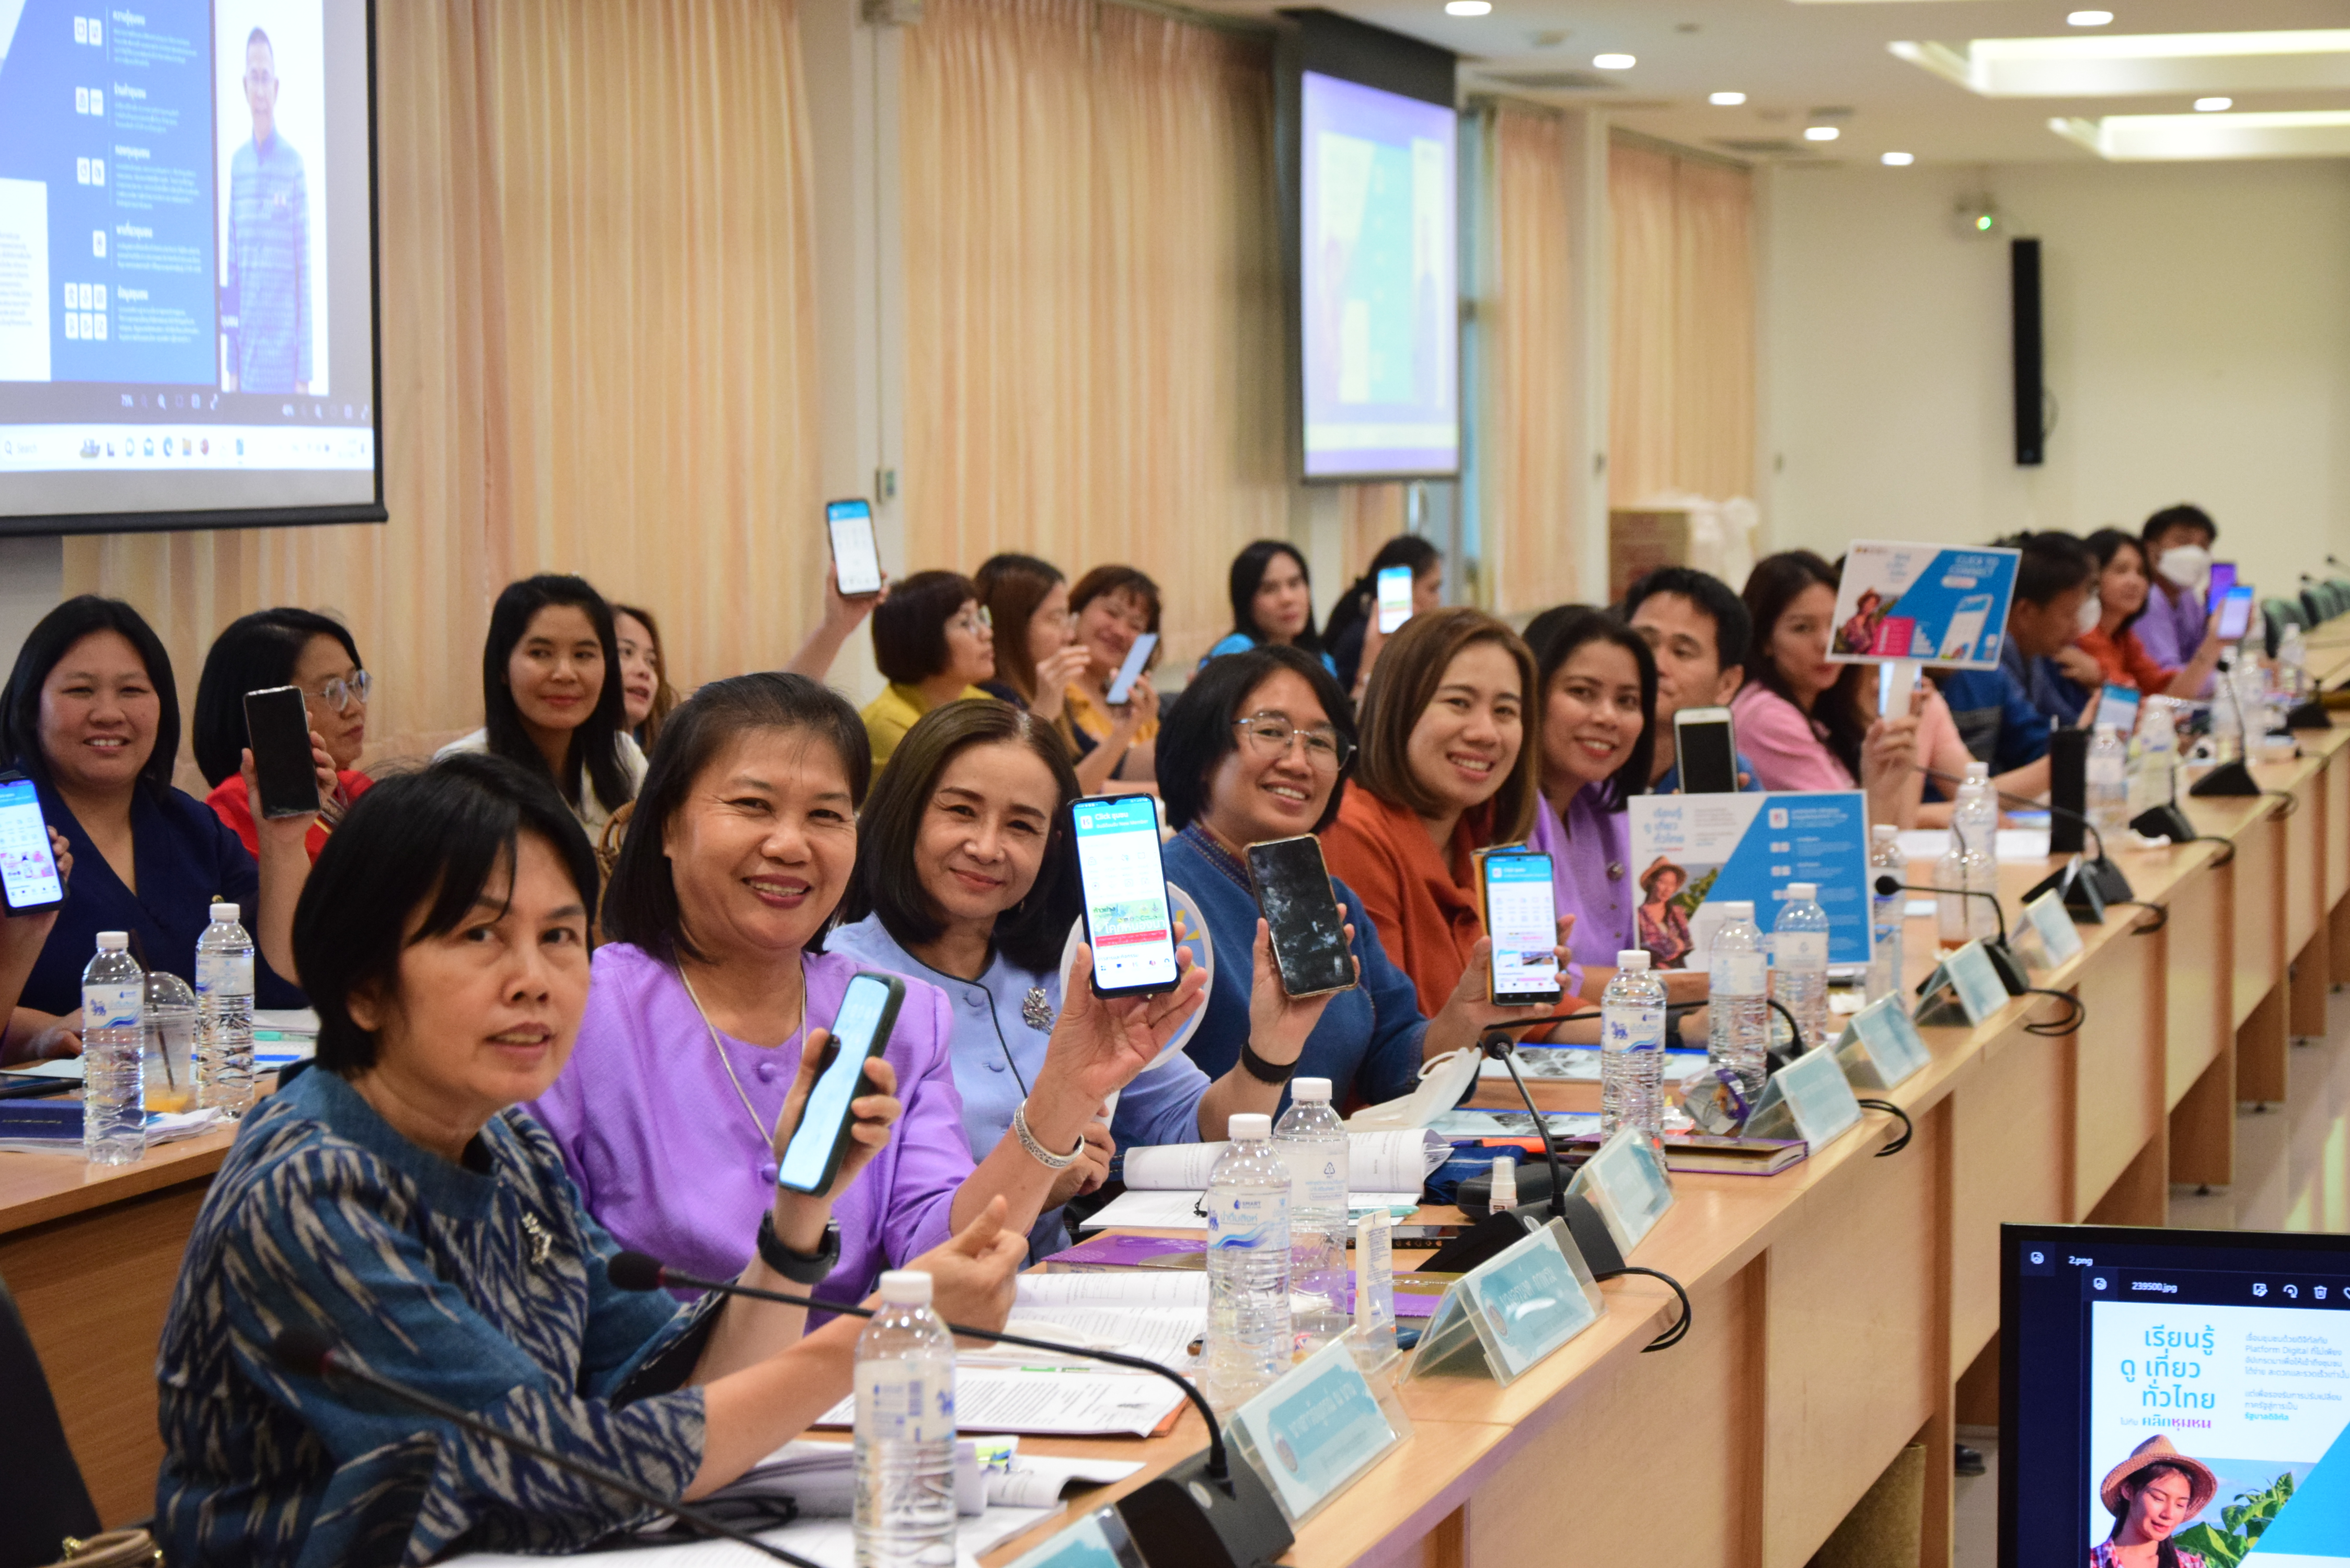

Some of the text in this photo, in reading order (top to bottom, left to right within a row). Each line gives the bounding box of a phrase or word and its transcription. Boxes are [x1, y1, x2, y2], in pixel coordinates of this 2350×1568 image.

[2068, 1255, 2093, 1267] 2.png
[2131, 1282, 2178, 1294] 239500.jpg
[2145, 1324, 2215, 1356] เรียนรู้
[2245, 1345, 2280, 1353] Platform
[2283, 1346, 2308, 1356] Digital
[2121, 1348, 2202, 1383] ดู เที่ยว
[2142, 1379, 2216, 1410] ทั่วไทย
[2141, 1414, 2212, 1431] คลิกชุมชน
[2245, 1412, 2289, 1421] รัฐบาลดิจิทัล
